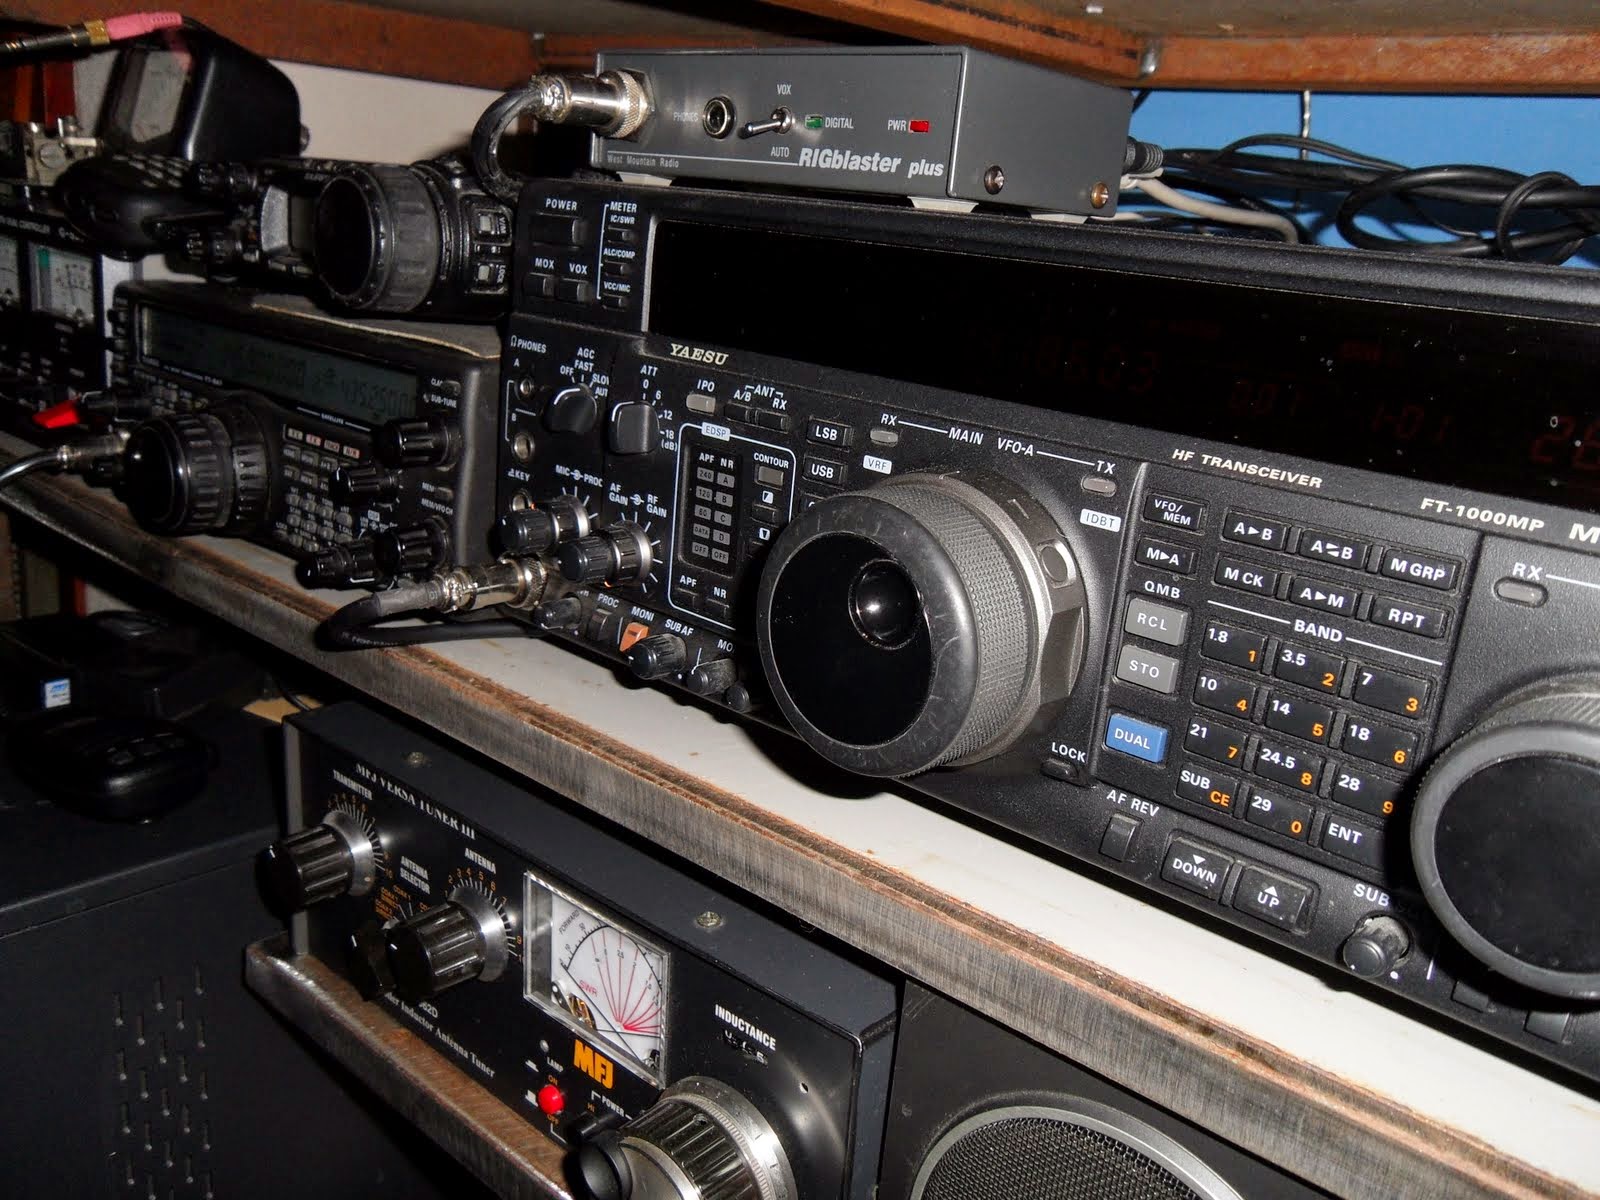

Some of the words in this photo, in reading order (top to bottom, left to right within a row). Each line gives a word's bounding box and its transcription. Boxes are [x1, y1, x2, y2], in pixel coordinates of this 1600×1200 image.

[776, 84, 792, 96] VOX
[673, 111, 699, 122] PHONES
[824, 117, 854, 130] DIGITAL
[888, 119, 906, 132] PWR
[771, 146, 790, 158] AUTO
[607, 154, 623, 164] West
[627, 155, 656, 167] Mountain
[660, 158, 680, 168] Radio
[799, 147, 902, 174] RIGblaster
[908, 158, 944, 178] plus
[545, 198, 578, 212] POWER
[610, 201, 638, 214] METER
[610, 215, 636, 226] IC/SWR
[603, 248, 636, 260] ALC/COMP
[535, 258, 554, 270] MOX
[569, 263, 588, 276] VOX
[603, 281, 631, 293] VCC/MIC
[517, 338, 547, 354] PHONES
[577, 346, 595, 360] AGC
[514, 358, 520, 367] A
[670, 343, 729, 366] YAESU
[560, 365, 574, 376] OFF
[574, 360, 594, 372] FAST
[640, 364, 658, 378] ATT
[595, 386, 608, 398] AUT
[643, 378, 649, 390] 0
[697, 378, 716, 393] IPO
[754, 384, 776, 398] ANT
[656, 391, 662, 400] 6
[734, 389, 751, 402] A/B
[772, 398, 788, 410] RX
[880, 414, 898, 426] RX
[705, 426, 728, 438] EDSP
[815, 426, 838, 442] LSB
[661, 440, 678, 452] (dB)
[949, 428, 984, 446] MAIN
[997, 438, 1034, 457] VFO-A
[699, 452, 714, 464] APF
[754, 452, 790, 469] CONTOUR
[867, 458, 888, 470] VRF
[515, 469, 530, 482] KEY
[556, 464, 570, 476] MIC
[584, 474, 604, 488] PROC
[811, 463, 834, 479] USB
[1096, 460, 1116, 476] TX
[1172, 448, 1195, 462] HF
[1201, 454, 1324, 490] TRANSCEIVER
[610, 482, 621, 494] AF
[608, 493, 628, 506] GAIN
[647, 494, 658, 504] RF
[1154, 498, 1184, 514] VFO/
[646, 504, 667, 518] GAIN
[1163, 511, 1192, 526] MEM
[1420, 498, 1546, 532] FT-1000MP
[1086, 513, 1116, 529] IDBT
[1224, 567, 1240, 581] M
[1242, 572, 1264, 588] CK
[1390, 558, 1406, 574] M
[1410, 562, 1446, 582] GRP
[1512, 562, 1543, 581] RX
[680, 575, 697, 588] APF
[714, 586, 727, 598] NR
[1144, 580, 1181, 600] QMB
[598, 593, 620, 608] PROC
[632, 606, 655, 622] MONI
[1137, 612, 1168, 631] RCL
[1388, 608, 1426, 629] RPT
[1294, 620, 1343, 642] BAND
[1208, 628, 1228, 644] 1.8
[1248, 650, 1256, 662] 1
[1129, 660, 1160, 678] STO
[1282, 650, 1306, 667] 3.5
[1322, 672, 1335, 687] 2
[1200, 676, 1218, 692] 10
[1236, 699, 1248, 712] 4
[1362, 672, 1374, 686] 7
[1406, 698, 1419, 712] 3
[1272, 700, 1290, 716] 14
[1312, 724, 1324, 737] 5
[1114, 728, 1151, 750] DUAL
[1190, 723, 1208, 739] 21
[1228, 746, 1239, 760] 7
[1350, 724, 1370, 742] 18
[1394, 750, 1406, 765] 6
[1050, 742, 1087, 764] LOCK
[1260, 748, 1296, 770] 24.5
[1300, 772, 1312, 786] 8
[1180, 769, 1211, 790] SUB
[1210, 790, 1230, 808] CE
[1338, 774, 1362, 792] 28
[1382, 800, 1394, 815] 9
[1106, 788, 1128, 806] AF
[1130, 796, 1160, 818] REV
[1252, 795, 1272, 812] 29
[1291, 820, 1302, 834] 0
[1328, 822, 1362, 845] ENT
[401, 856, 429, 880] ANTENNA
[464, 848, 496, 874] ANTENNA
[1172, 857, 1218, 886] DOWN
[400, 868, 430, 895] SELECTOR
[1257, 890, 1280, 908] UP
[1354, 882, 1390, 908] SUB
[579, 980, 598, 998] SWR
[714, 1004, 777, 1052] INDUCTANCE
[402, 1001, 434, 1032] Inductor
[436, 1027, 468, 1059] Antenna
[470, 1052, 496, 1078] Tuner
[547, 1056, 564, 1072] LAMP
[574, 1040, 614, 1090] MFJ
[602, 1095, 625, 1118] POWER
